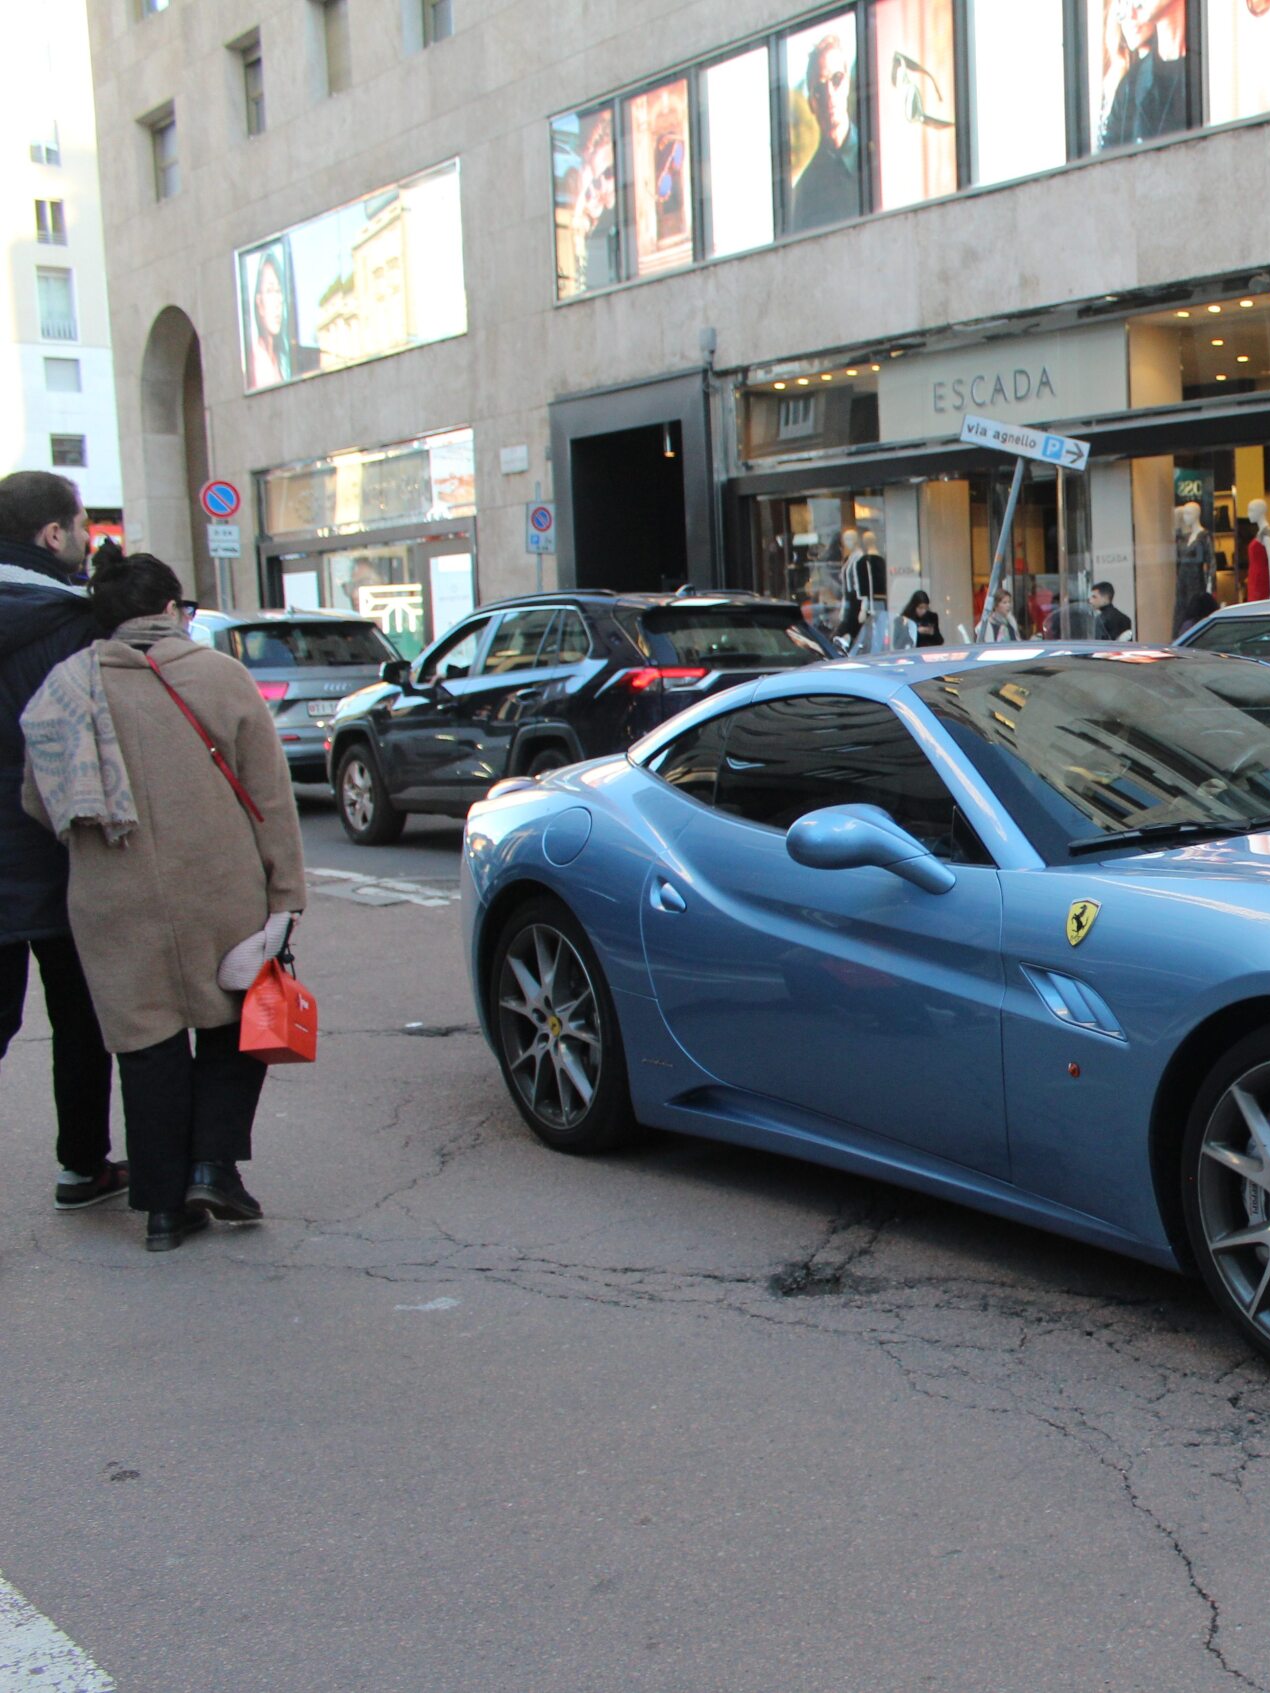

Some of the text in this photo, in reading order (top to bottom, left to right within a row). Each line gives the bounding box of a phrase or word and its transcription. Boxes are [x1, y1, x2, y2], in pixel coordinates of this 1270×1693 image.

[933, 365, 1056, 413] ESCADA
[967, 423, 988, 437] via
[993, 429, 1037, 449] agnello
